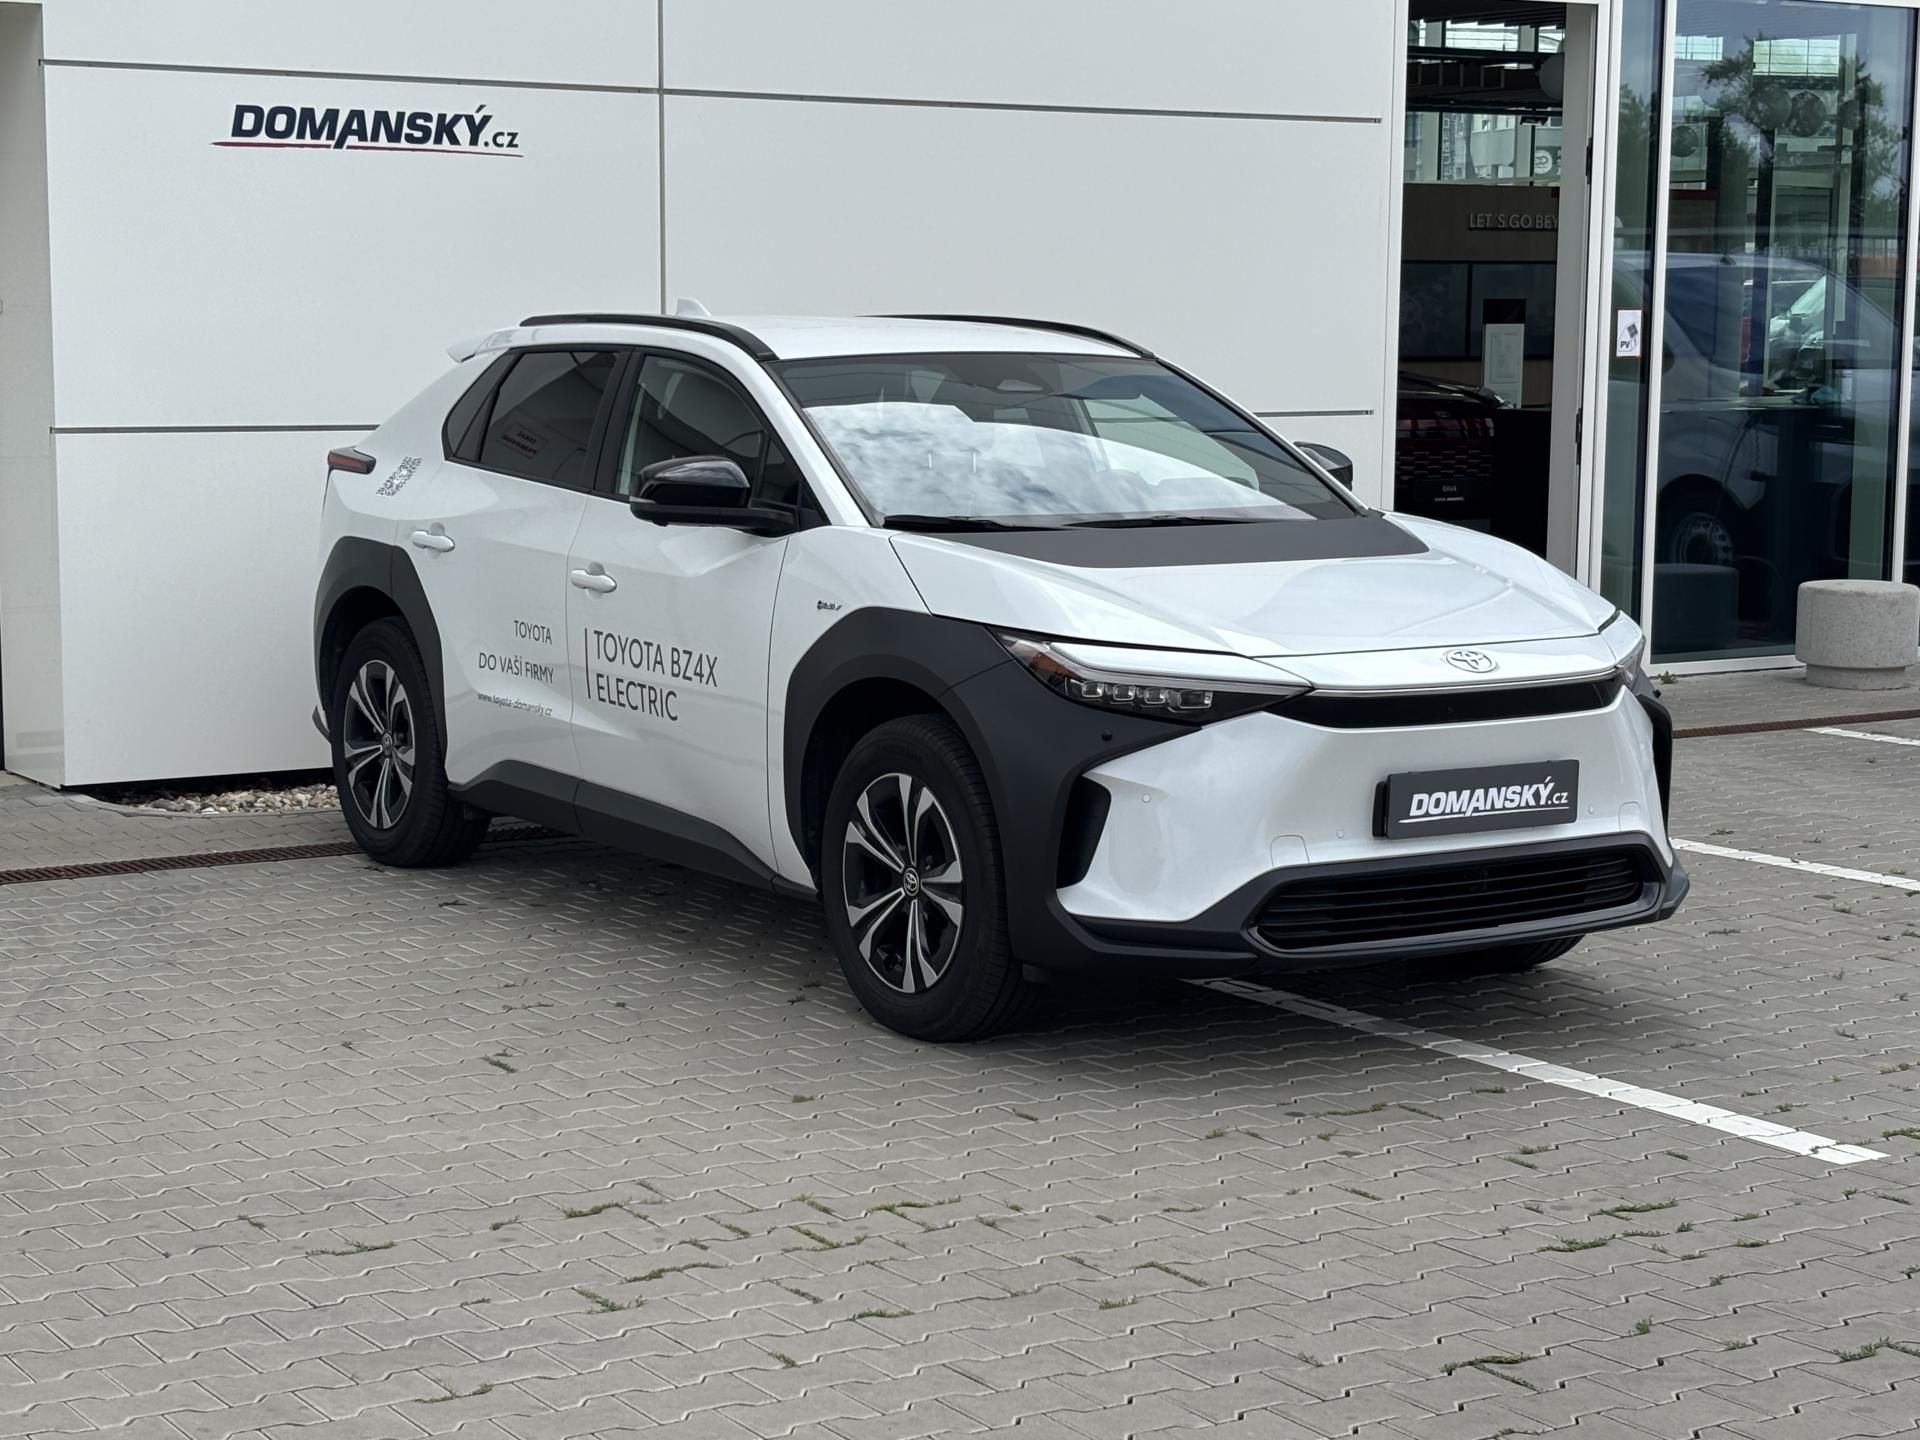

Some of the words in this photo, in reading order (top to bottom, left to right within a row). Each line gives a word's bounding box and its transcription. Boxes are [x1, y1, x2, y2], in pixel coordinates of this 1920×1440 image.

[1509, 214, 1532, 229] GO
[1620, 340, 1631, 349] PV
[513, 620, 553, 645] TOYOTA
[478, 652, 497, 671] DO
[499, 655, 524, 677] VAŠÍ
[525, 661, 554, 684] FIRMY
[593, 630, 665, 675] TOYOTA
[671, 647, 718, 688] BZ4X
[596, 673, 679, 722] ELECTRIC
